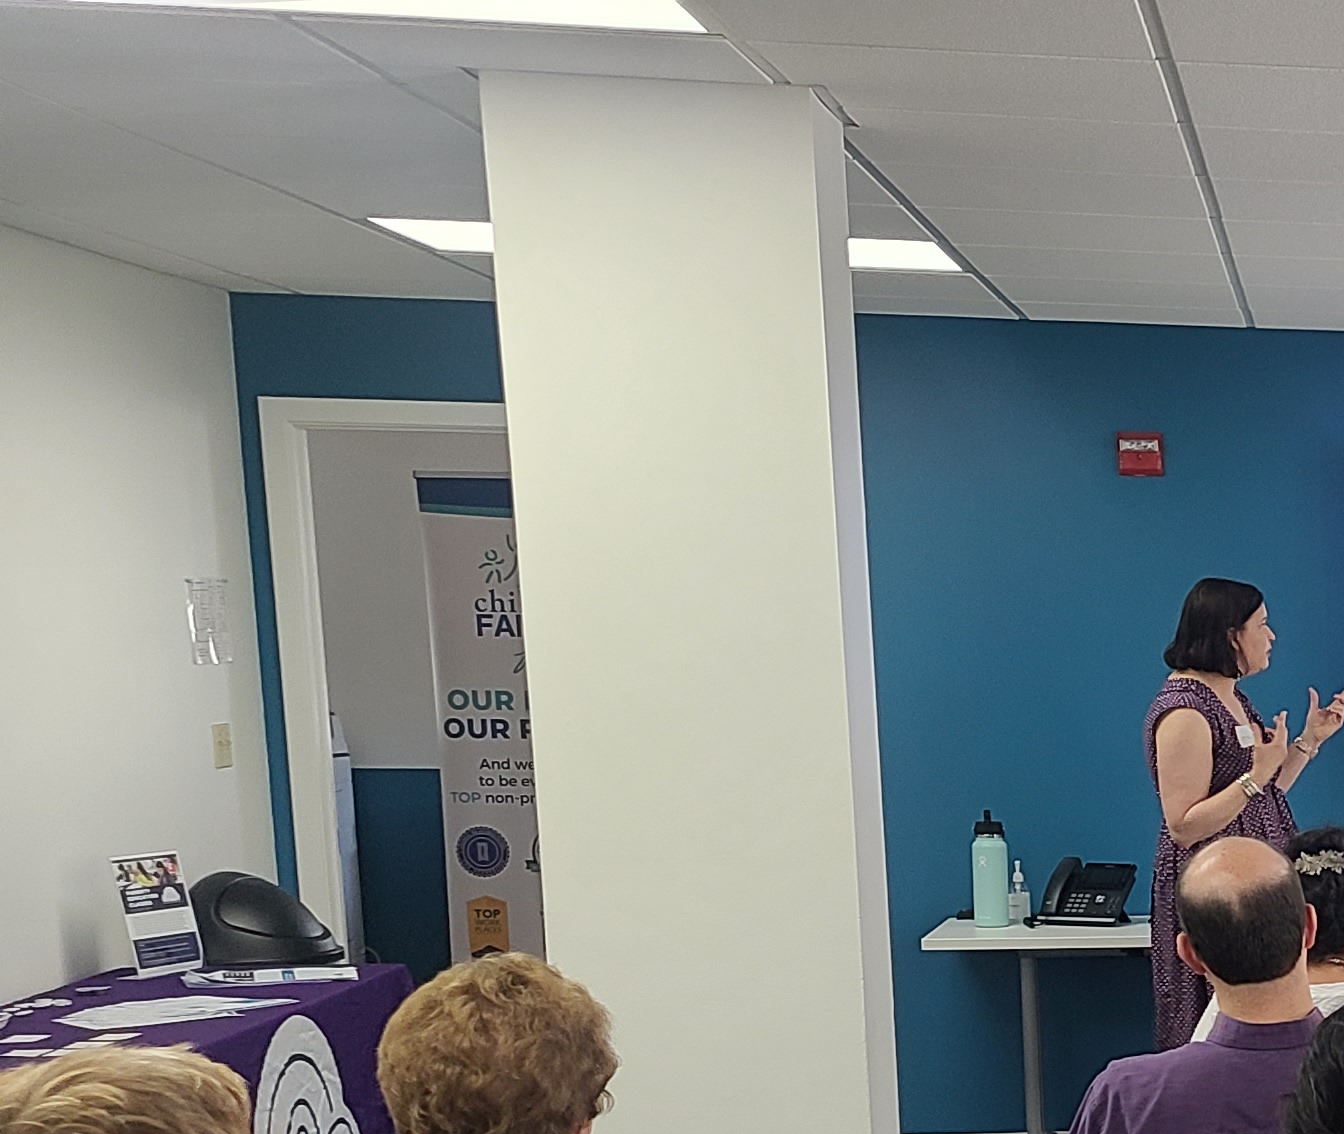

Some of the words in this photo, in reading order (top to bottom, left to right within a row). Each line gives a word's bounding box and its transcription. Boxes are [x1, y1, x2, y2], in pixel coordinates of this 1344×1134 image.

[474, 588, 518, 613] chi
[447, 689, 514, 711] OUR
[444, 717, 511, 739] OUR
[479, 757, 511, 770] And
[479, 776, 495, 787] to
[499, 775, 518, 787] be
[450, 791, 481, 803] TOP
[485, 794, 535, 806] non-pr
[474, 909, 501, 918] TOP
